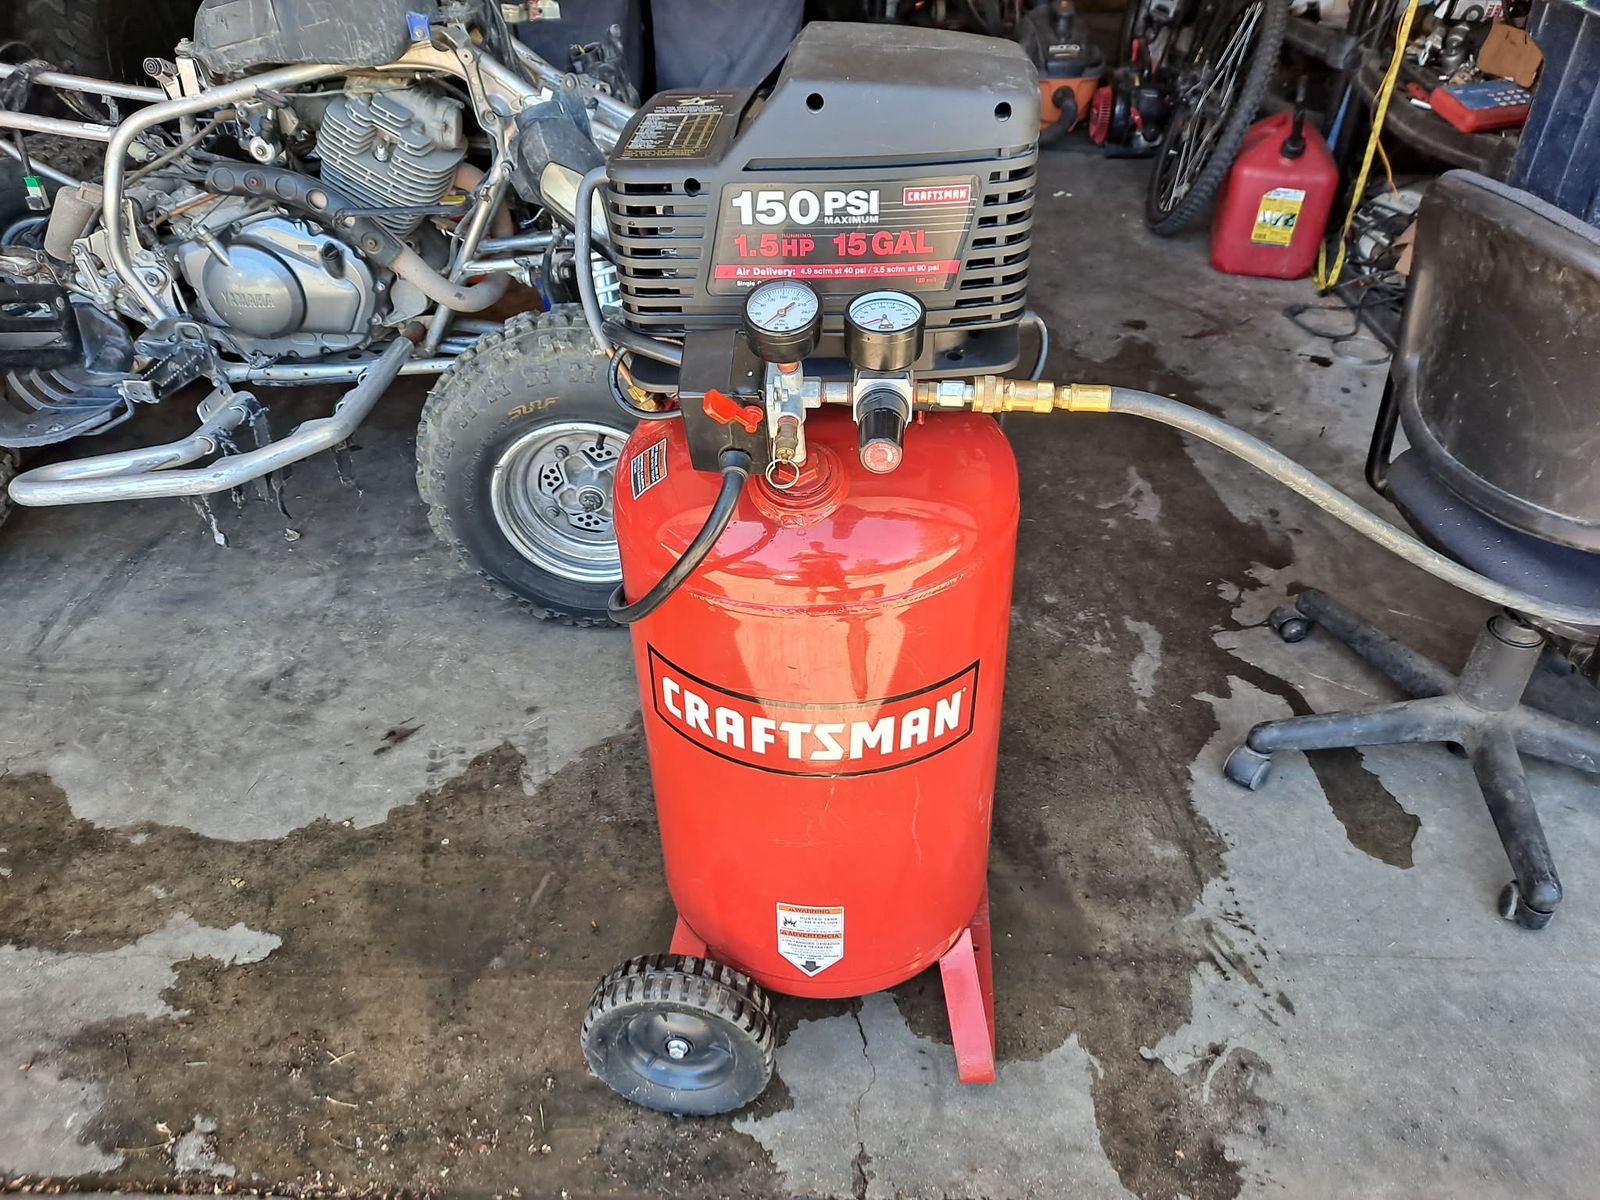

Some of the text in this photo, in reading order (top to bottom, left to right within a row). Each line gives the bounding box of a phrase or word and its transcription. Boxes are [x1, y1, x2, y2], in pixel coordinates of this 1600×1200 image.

[907, 188, 967, 202] CRAFTSMAN
[731, 190, 880, 225] 150 PSI
[824, 215, 879, 225] MAXIMUM
[735, 230, 934, 257] 1.5 HP 15 GAL
[736, 267, 750, 276] Air
[753, 266, 796, 278] Delivery:
[800, 267, 811, 275] 4.9
[813, 267, 833, 275] scfm
[834, 267, 843, 275] at
[844, 266, 853, 274] 40
[854, 266, 867, 275] psi
[873, 265, 885, 273] 3.5
[887, 265, 905, 273] scfm
[916, 264, 926, 272] 90
[927, 263, 940, 272] psi
[736, 280, 756, 288] Single
[661, 675, 963, 761] CRAFTSMAN
